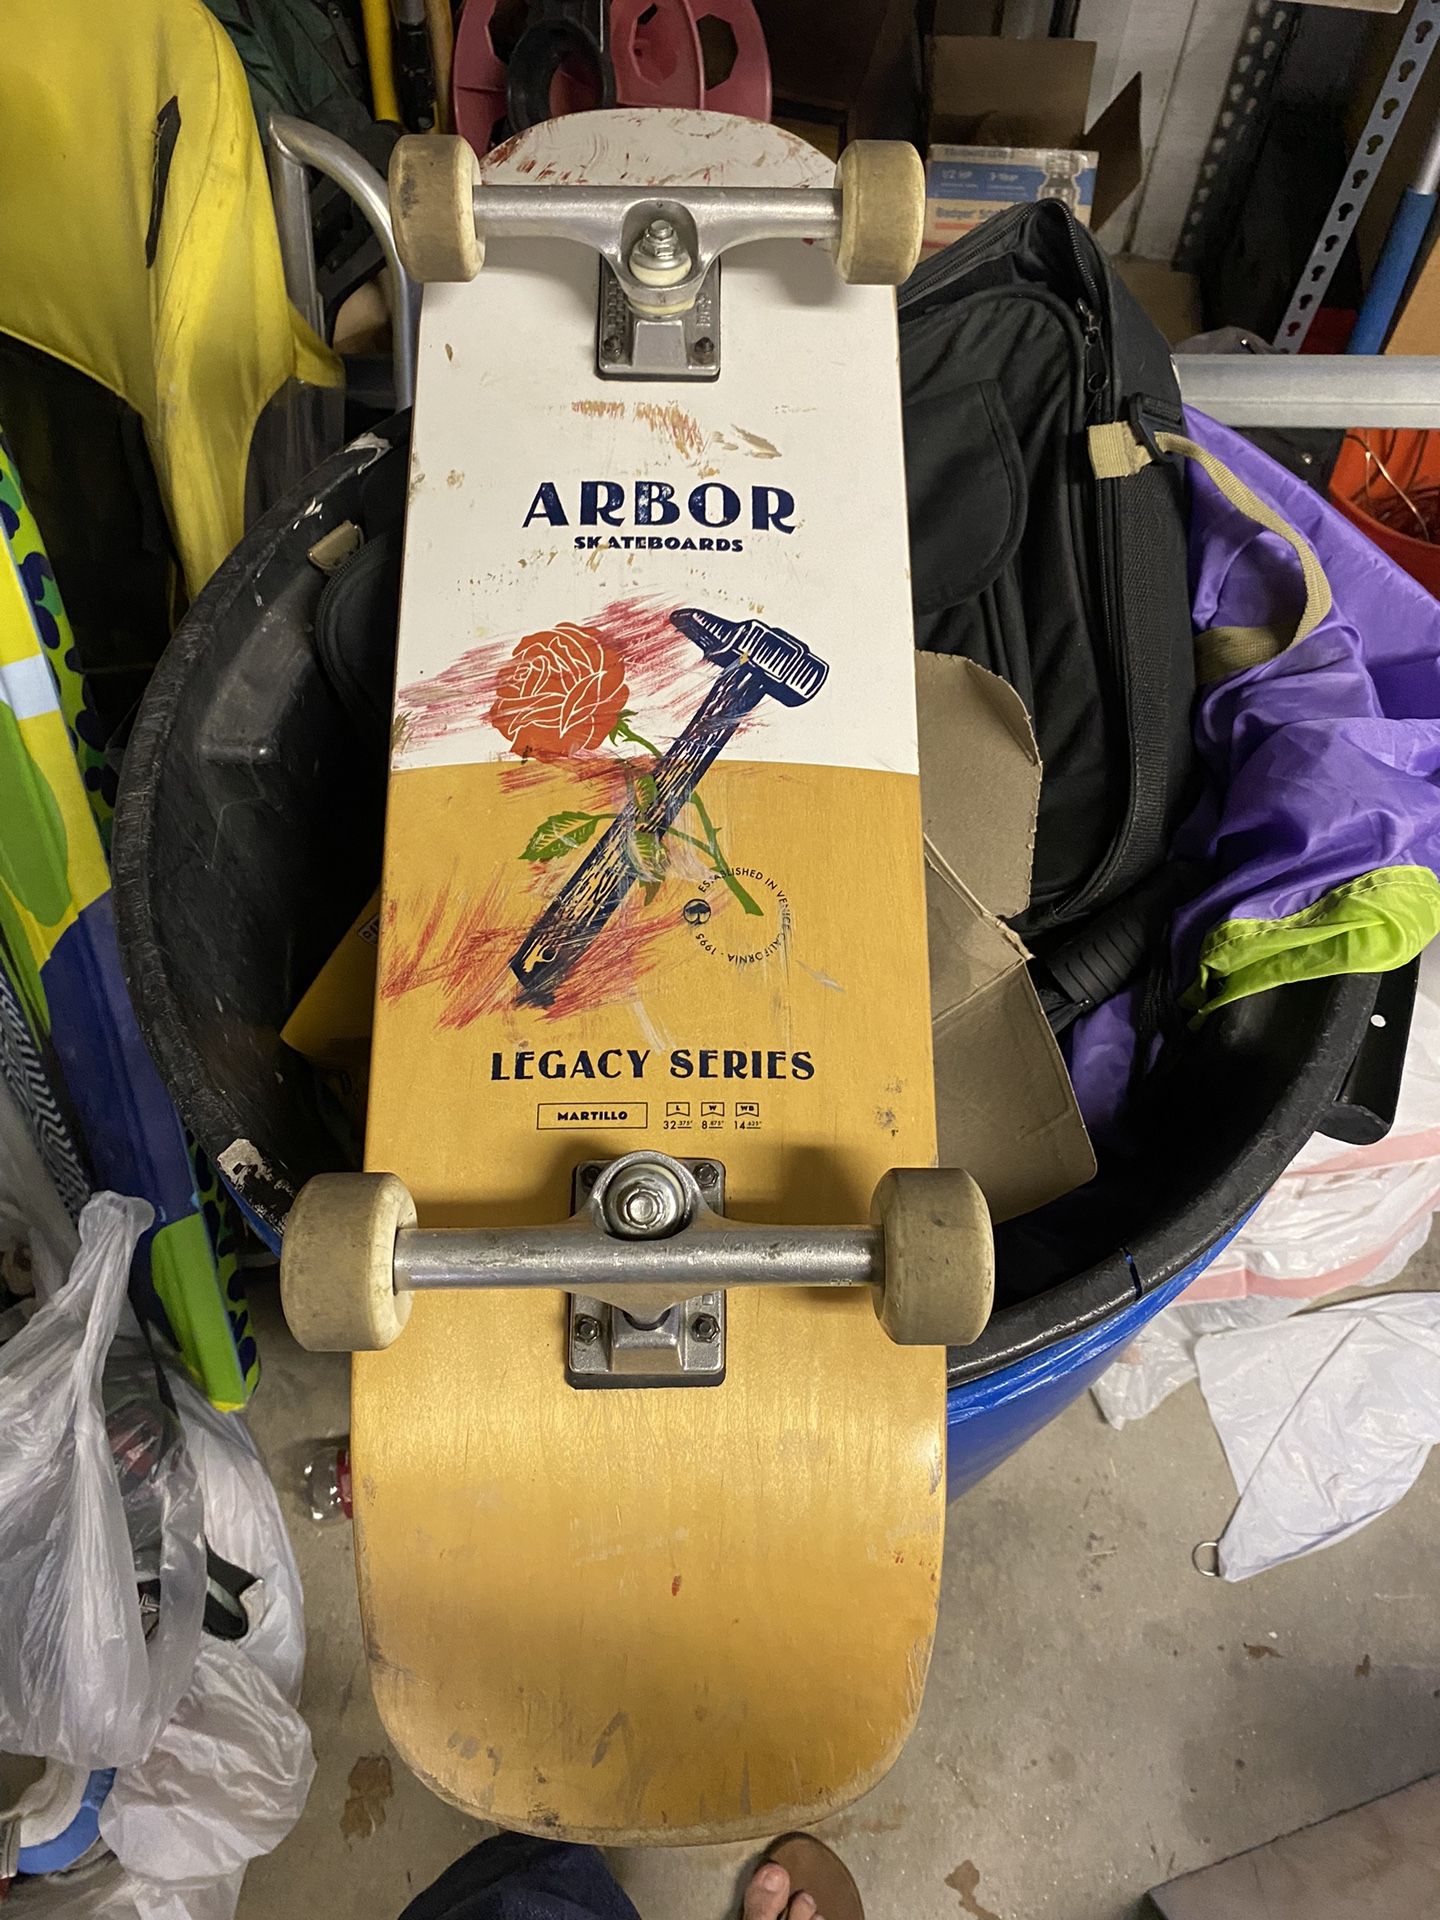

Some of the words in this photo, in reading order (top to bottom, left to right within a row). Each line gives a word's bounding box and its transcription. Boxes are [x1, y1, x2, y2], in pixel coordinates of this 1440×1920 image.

[521, 481, 795, 534] ARBOR
[574, 536, 744, 552] SKATEBOARDS
[764, 878, 777, 890] IN
[695, 933, 717, 955] 1995
[491, 1049, 650, 1081] LEGACY
[669, 1049, 815, 1080] SERIES
[557, 1110, 628, 1121] MARTILLO
